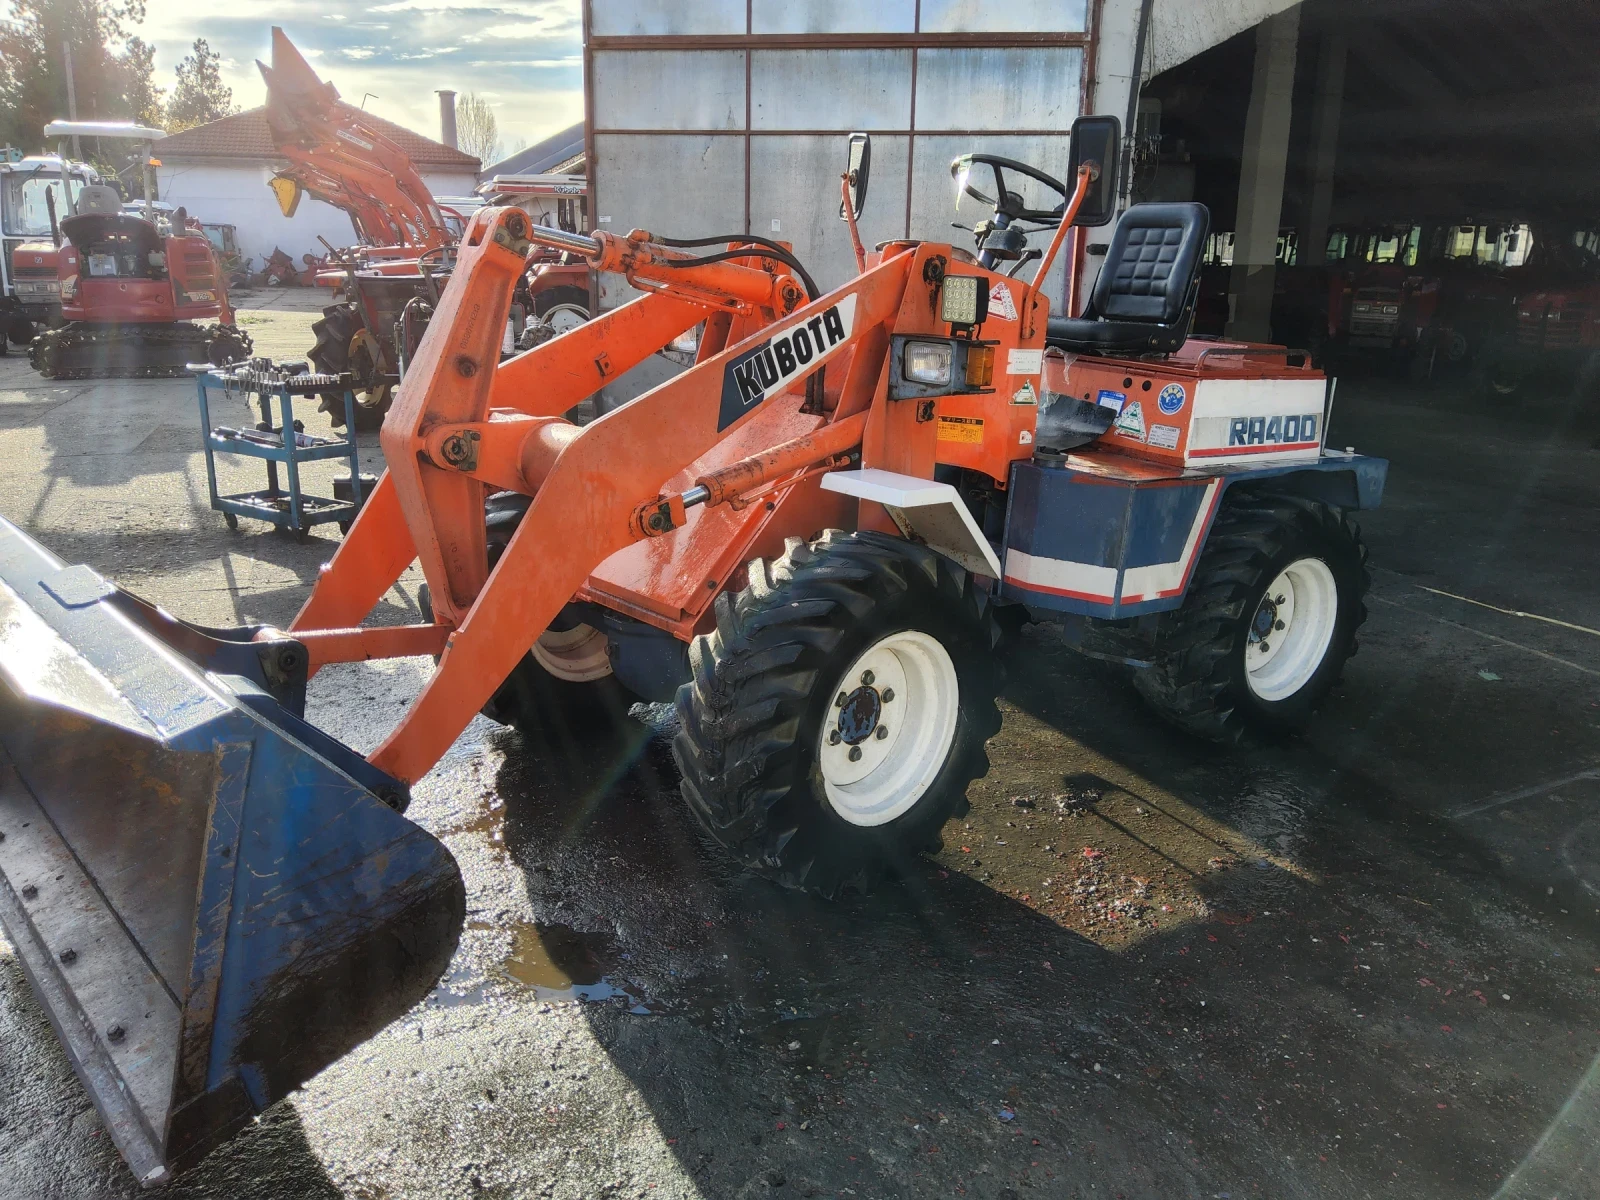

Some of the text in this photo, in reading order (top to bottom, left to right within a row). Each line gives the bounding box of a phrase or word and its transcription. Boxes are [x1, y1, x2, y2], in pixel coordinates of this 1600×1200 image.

[554, 186, 582, 194] Kubota
[414, 214, 430, 239] Kubota
[733, 305, 846, 405] KUBOTA
[1229, 415, 1318, 446] RA400
